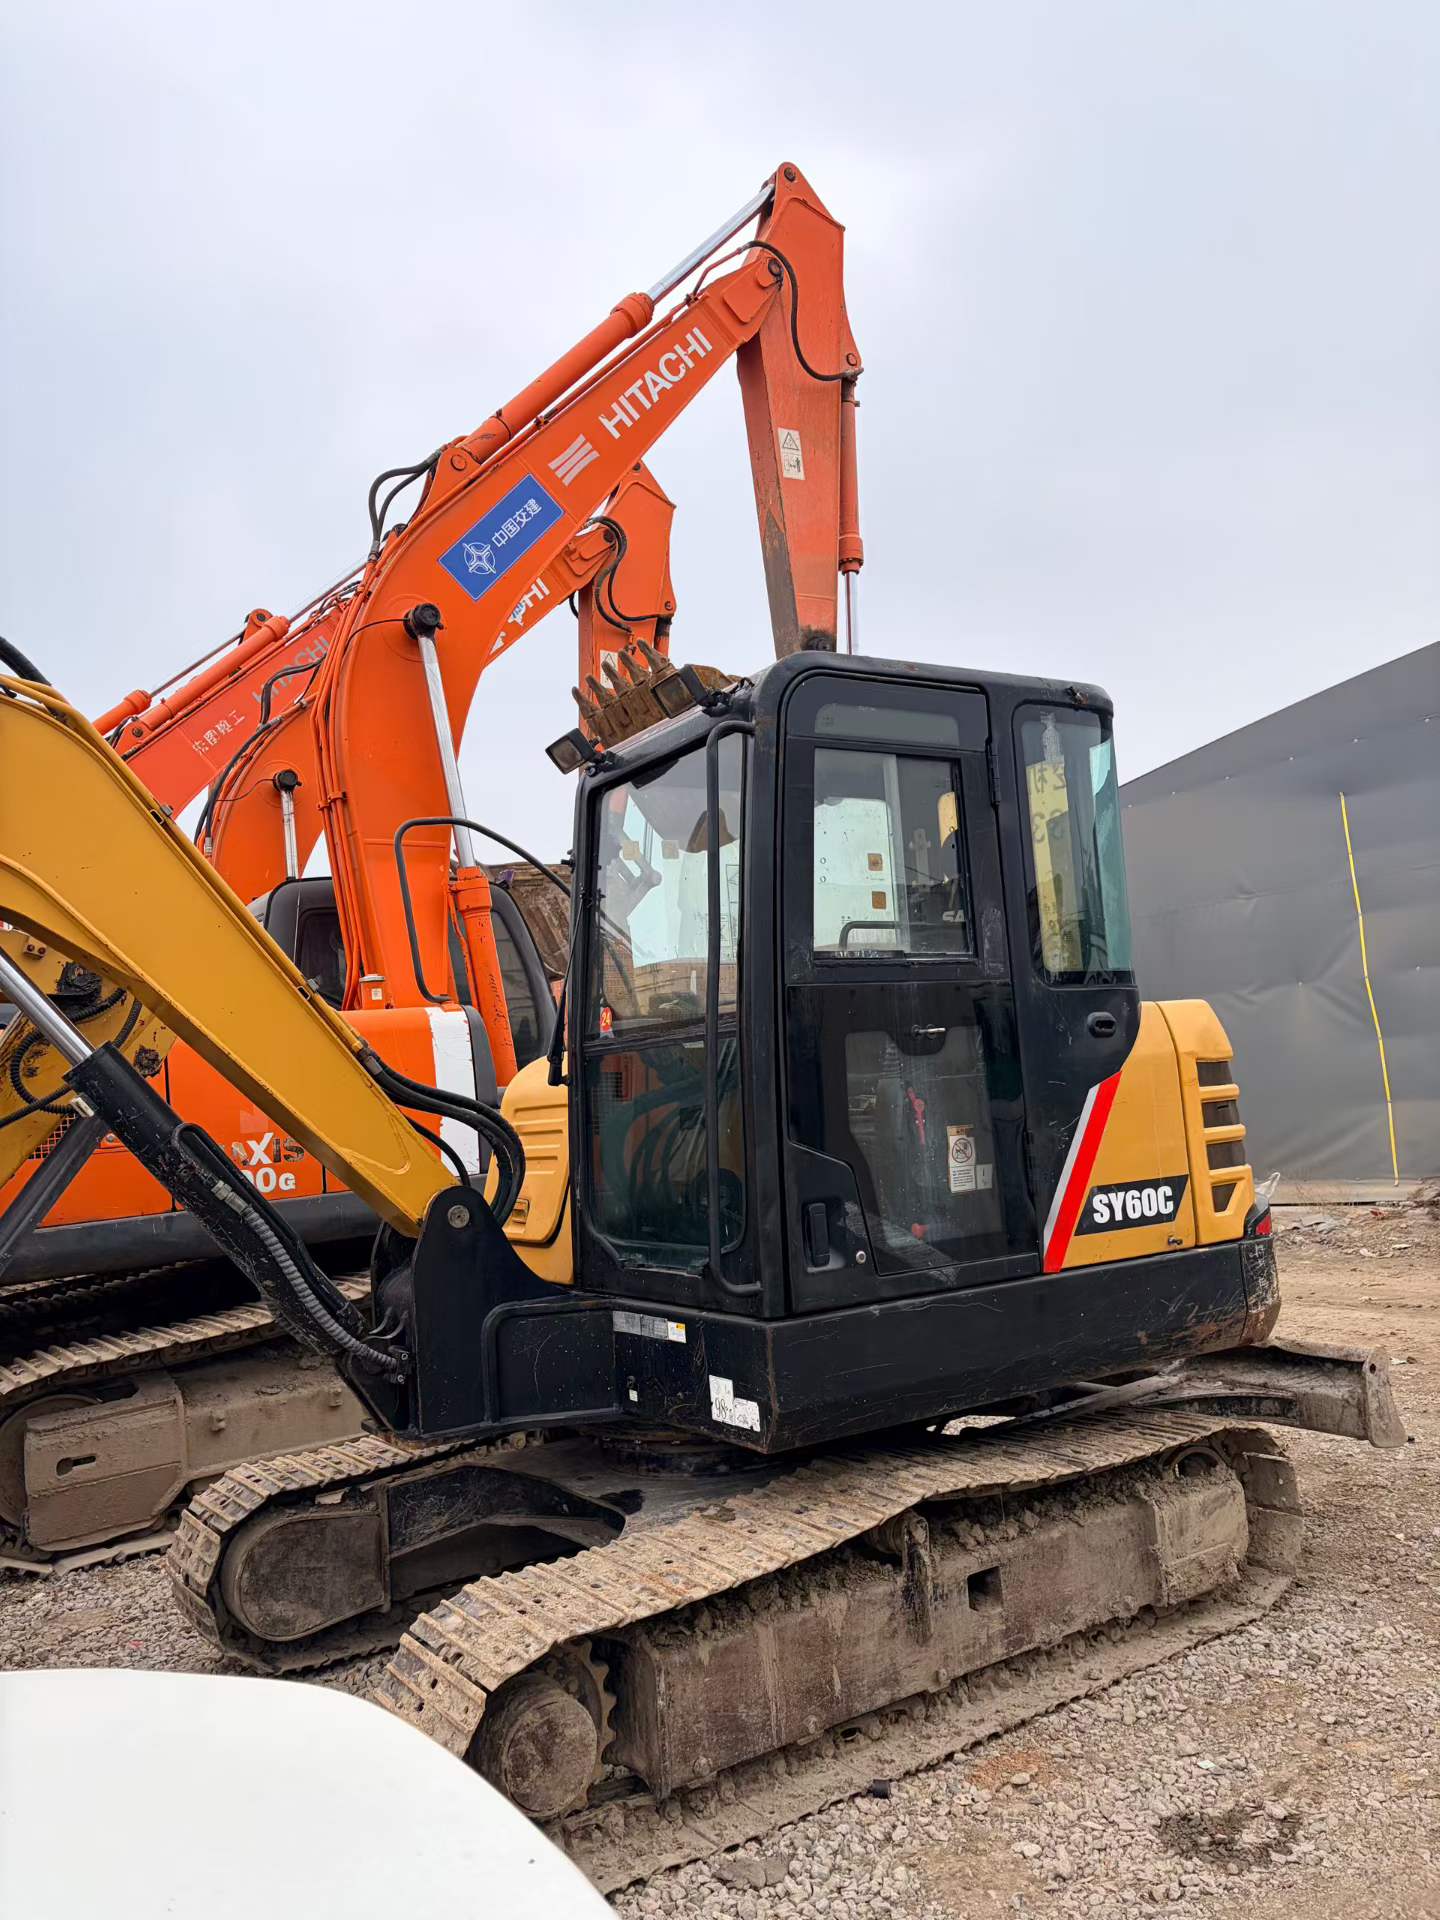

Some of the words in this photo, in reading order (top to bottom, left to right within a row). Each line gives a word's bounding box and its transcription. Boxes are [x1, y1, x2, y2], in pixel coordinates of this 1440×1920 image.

[598, 327, 713, 439] HITACHI
[491, 498, 542, 548] 中国交建
[220, 1131, 305, 1166] AXIS
[1092, 1185, 1174, 1224] SY60C
